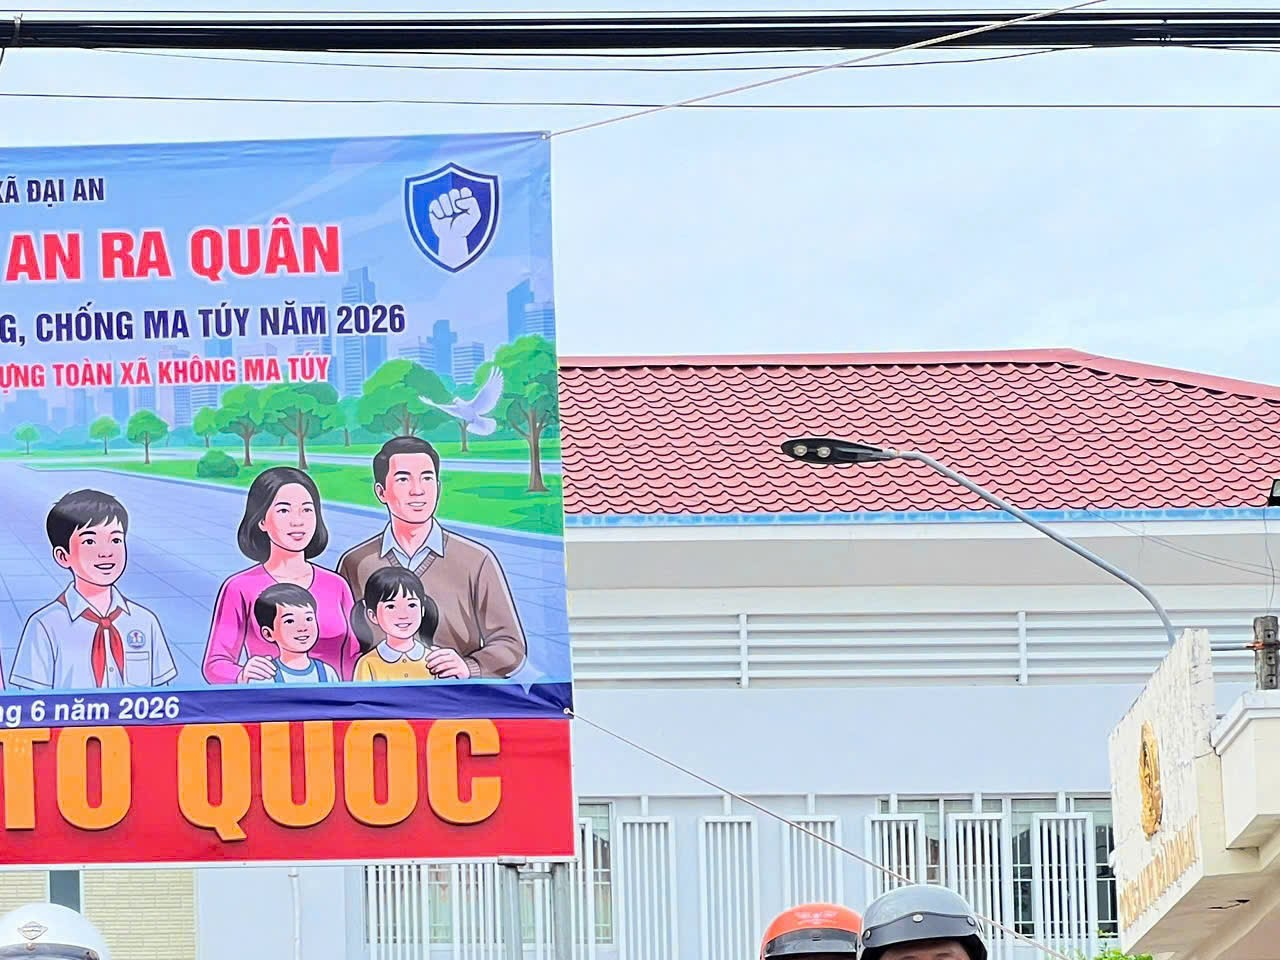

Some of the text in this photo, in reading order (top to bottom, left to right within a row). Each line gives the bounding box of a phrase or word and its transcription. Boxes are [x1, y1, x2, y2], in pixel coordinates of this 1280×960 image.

[27, 179, 64, 208] ĐẠI
[72, 178, 104, 202] AN
[4, 232, 80, 282] AN
[101, 230, 172, 279] RA
[190, 217, 339, 282] QUÂN
[35, 302, 133, 342] CHỐNG
[144, 310, 189, 340] MA
[198, 303, 250, 338] TÚY
[260, 302, 326, 336] NĂM
[336, 304, 405, 335] 2026
[52, 357, 110, 387] TOÀN
[120, 356, 149, 385] XÃ
[159, 353, 236, 384] KHÔNG
[244, 358, 281, 382] MA
[287, 351, 330, 382] TÚY
[30, 700, 45, 721] 6
[54, 697, 109, 721] năm
[119, 697, 180, 720] 2026
